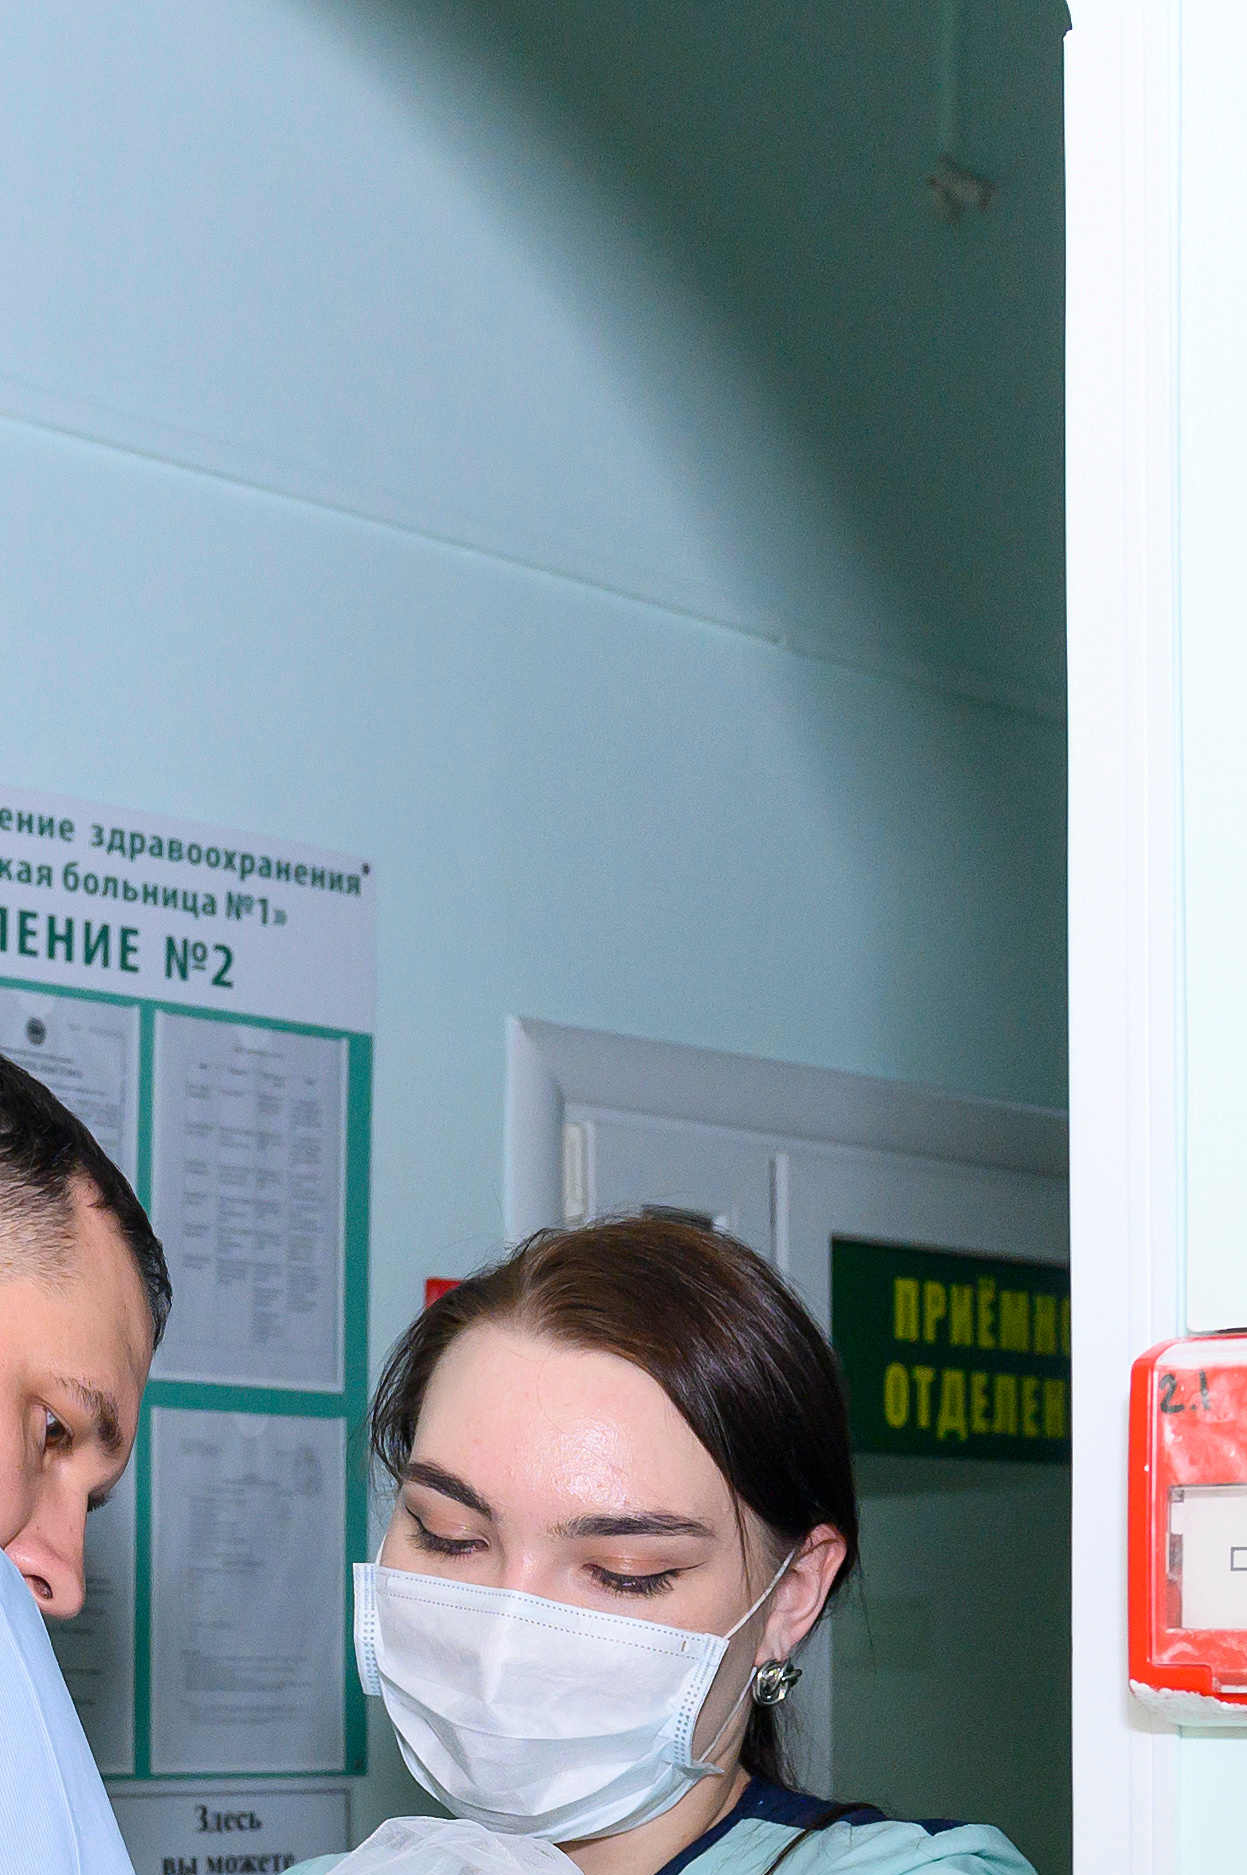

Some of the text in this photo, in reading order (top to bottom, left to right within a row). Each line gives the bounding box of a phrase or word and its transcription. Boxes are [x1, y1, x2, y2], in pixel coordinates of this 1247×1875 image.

[89, 822, 363, 899] здравоохранения
[63, 862, 218, 918] больница
[164, 934, 235, 989] №2
[884, 1361, 1066, 1441] ОТДЕЛЕН
[1159, 1371, 1211, 1414] 2.1
[195, 1804, 263, 1833] Здесь
